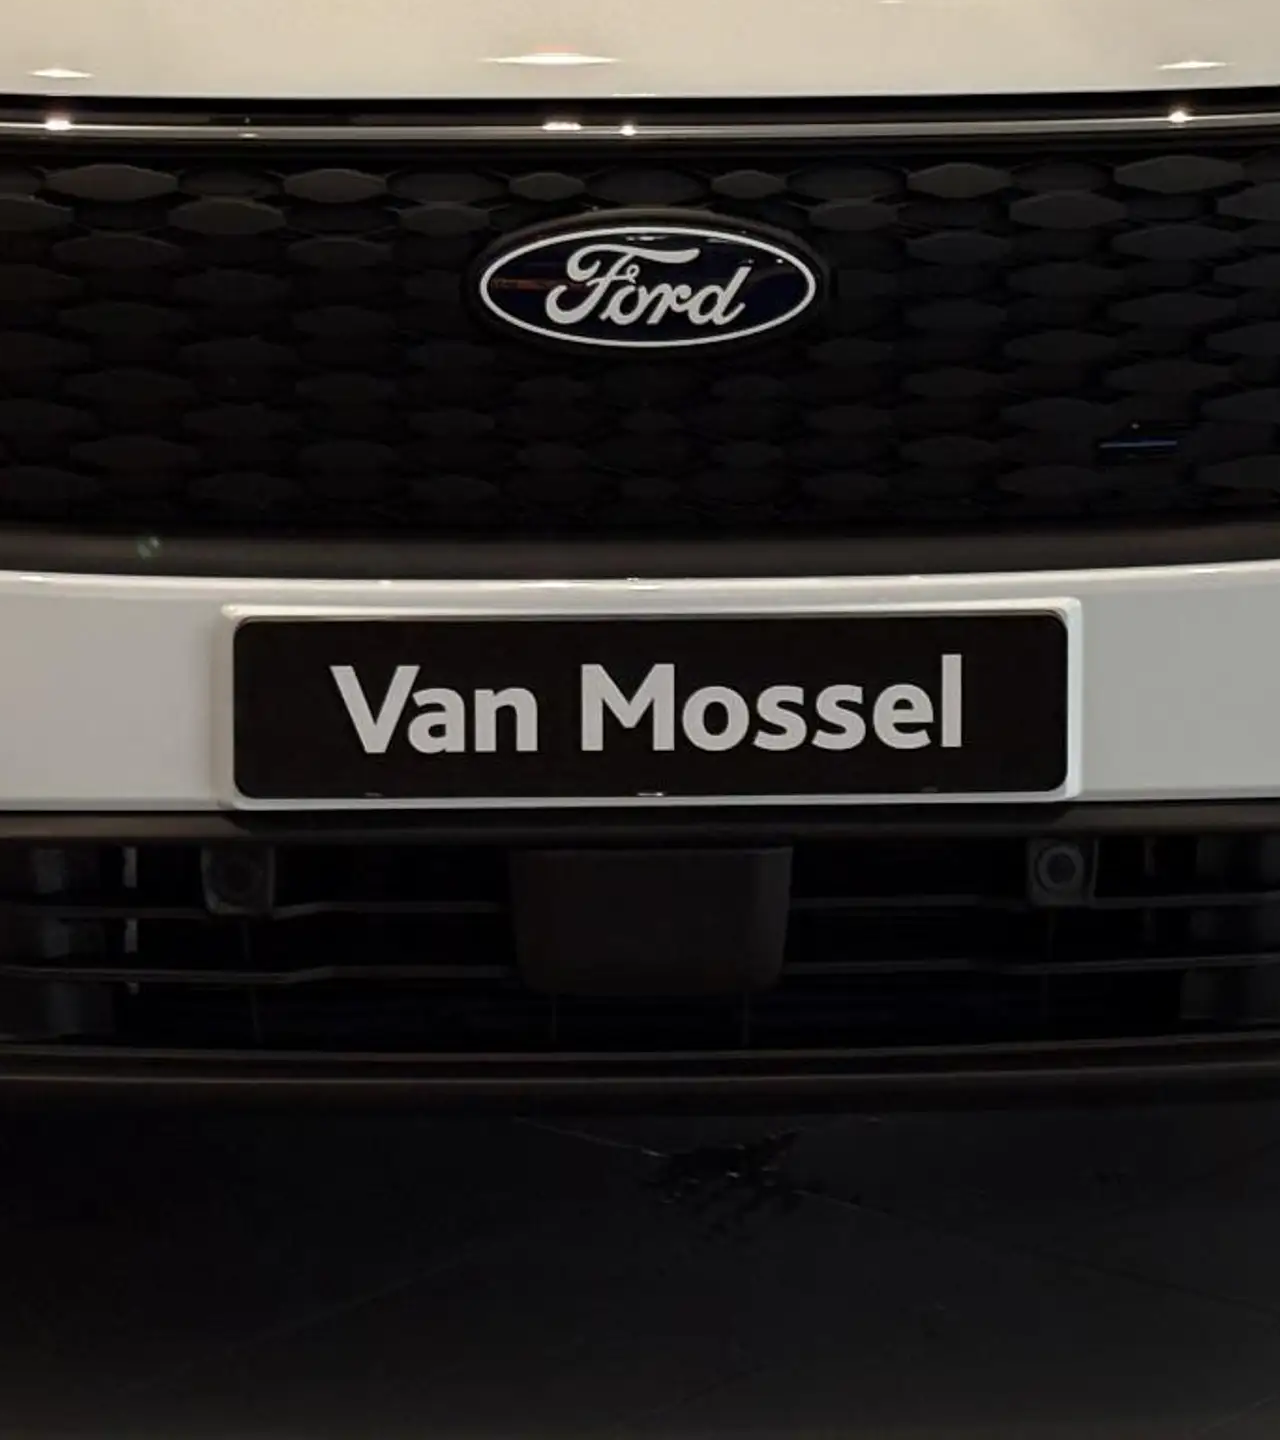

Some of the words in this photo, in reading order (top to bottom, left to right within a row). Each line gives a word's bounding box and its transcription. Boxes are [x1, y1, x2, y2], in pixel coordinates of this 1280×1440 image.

[544, 242, 752, 327] Ford
[329, 664, 538, 754] Van
[580, 653, 964, 752] Mossel
